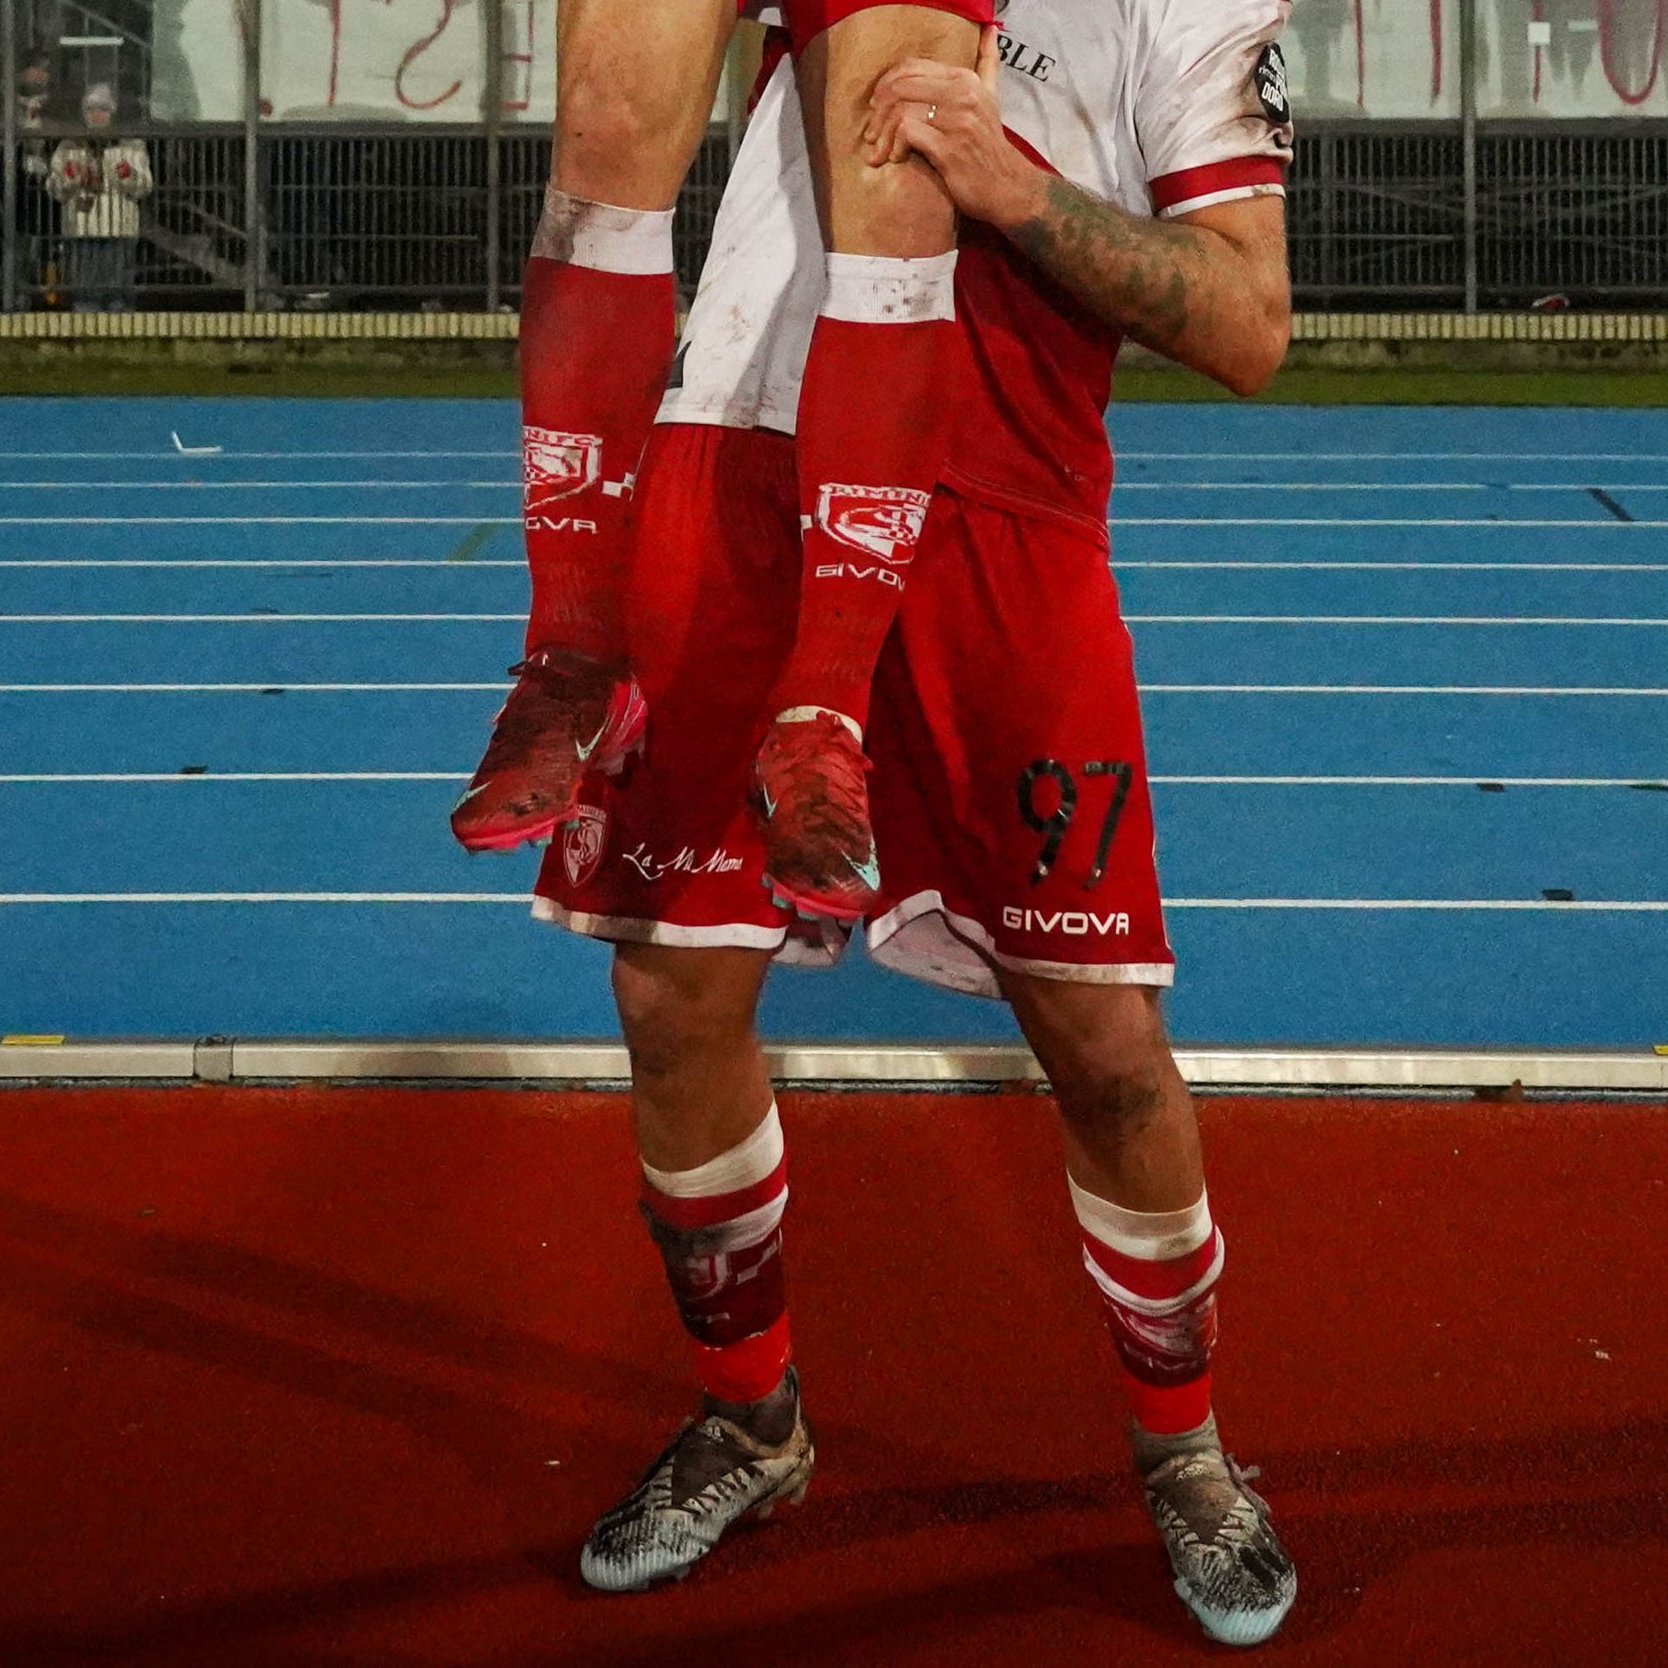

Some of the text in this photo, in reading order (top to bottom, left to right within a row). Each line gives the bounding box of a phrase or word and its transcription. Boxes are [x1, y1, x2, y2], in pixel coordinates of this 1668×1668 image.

[997, 33, 1056, 82] BLE
[815, 562, 906, 591] GIVOV
[1017, 759, 1132, 888] 97
[1003, 906, 1130, 936] GIVOVA
